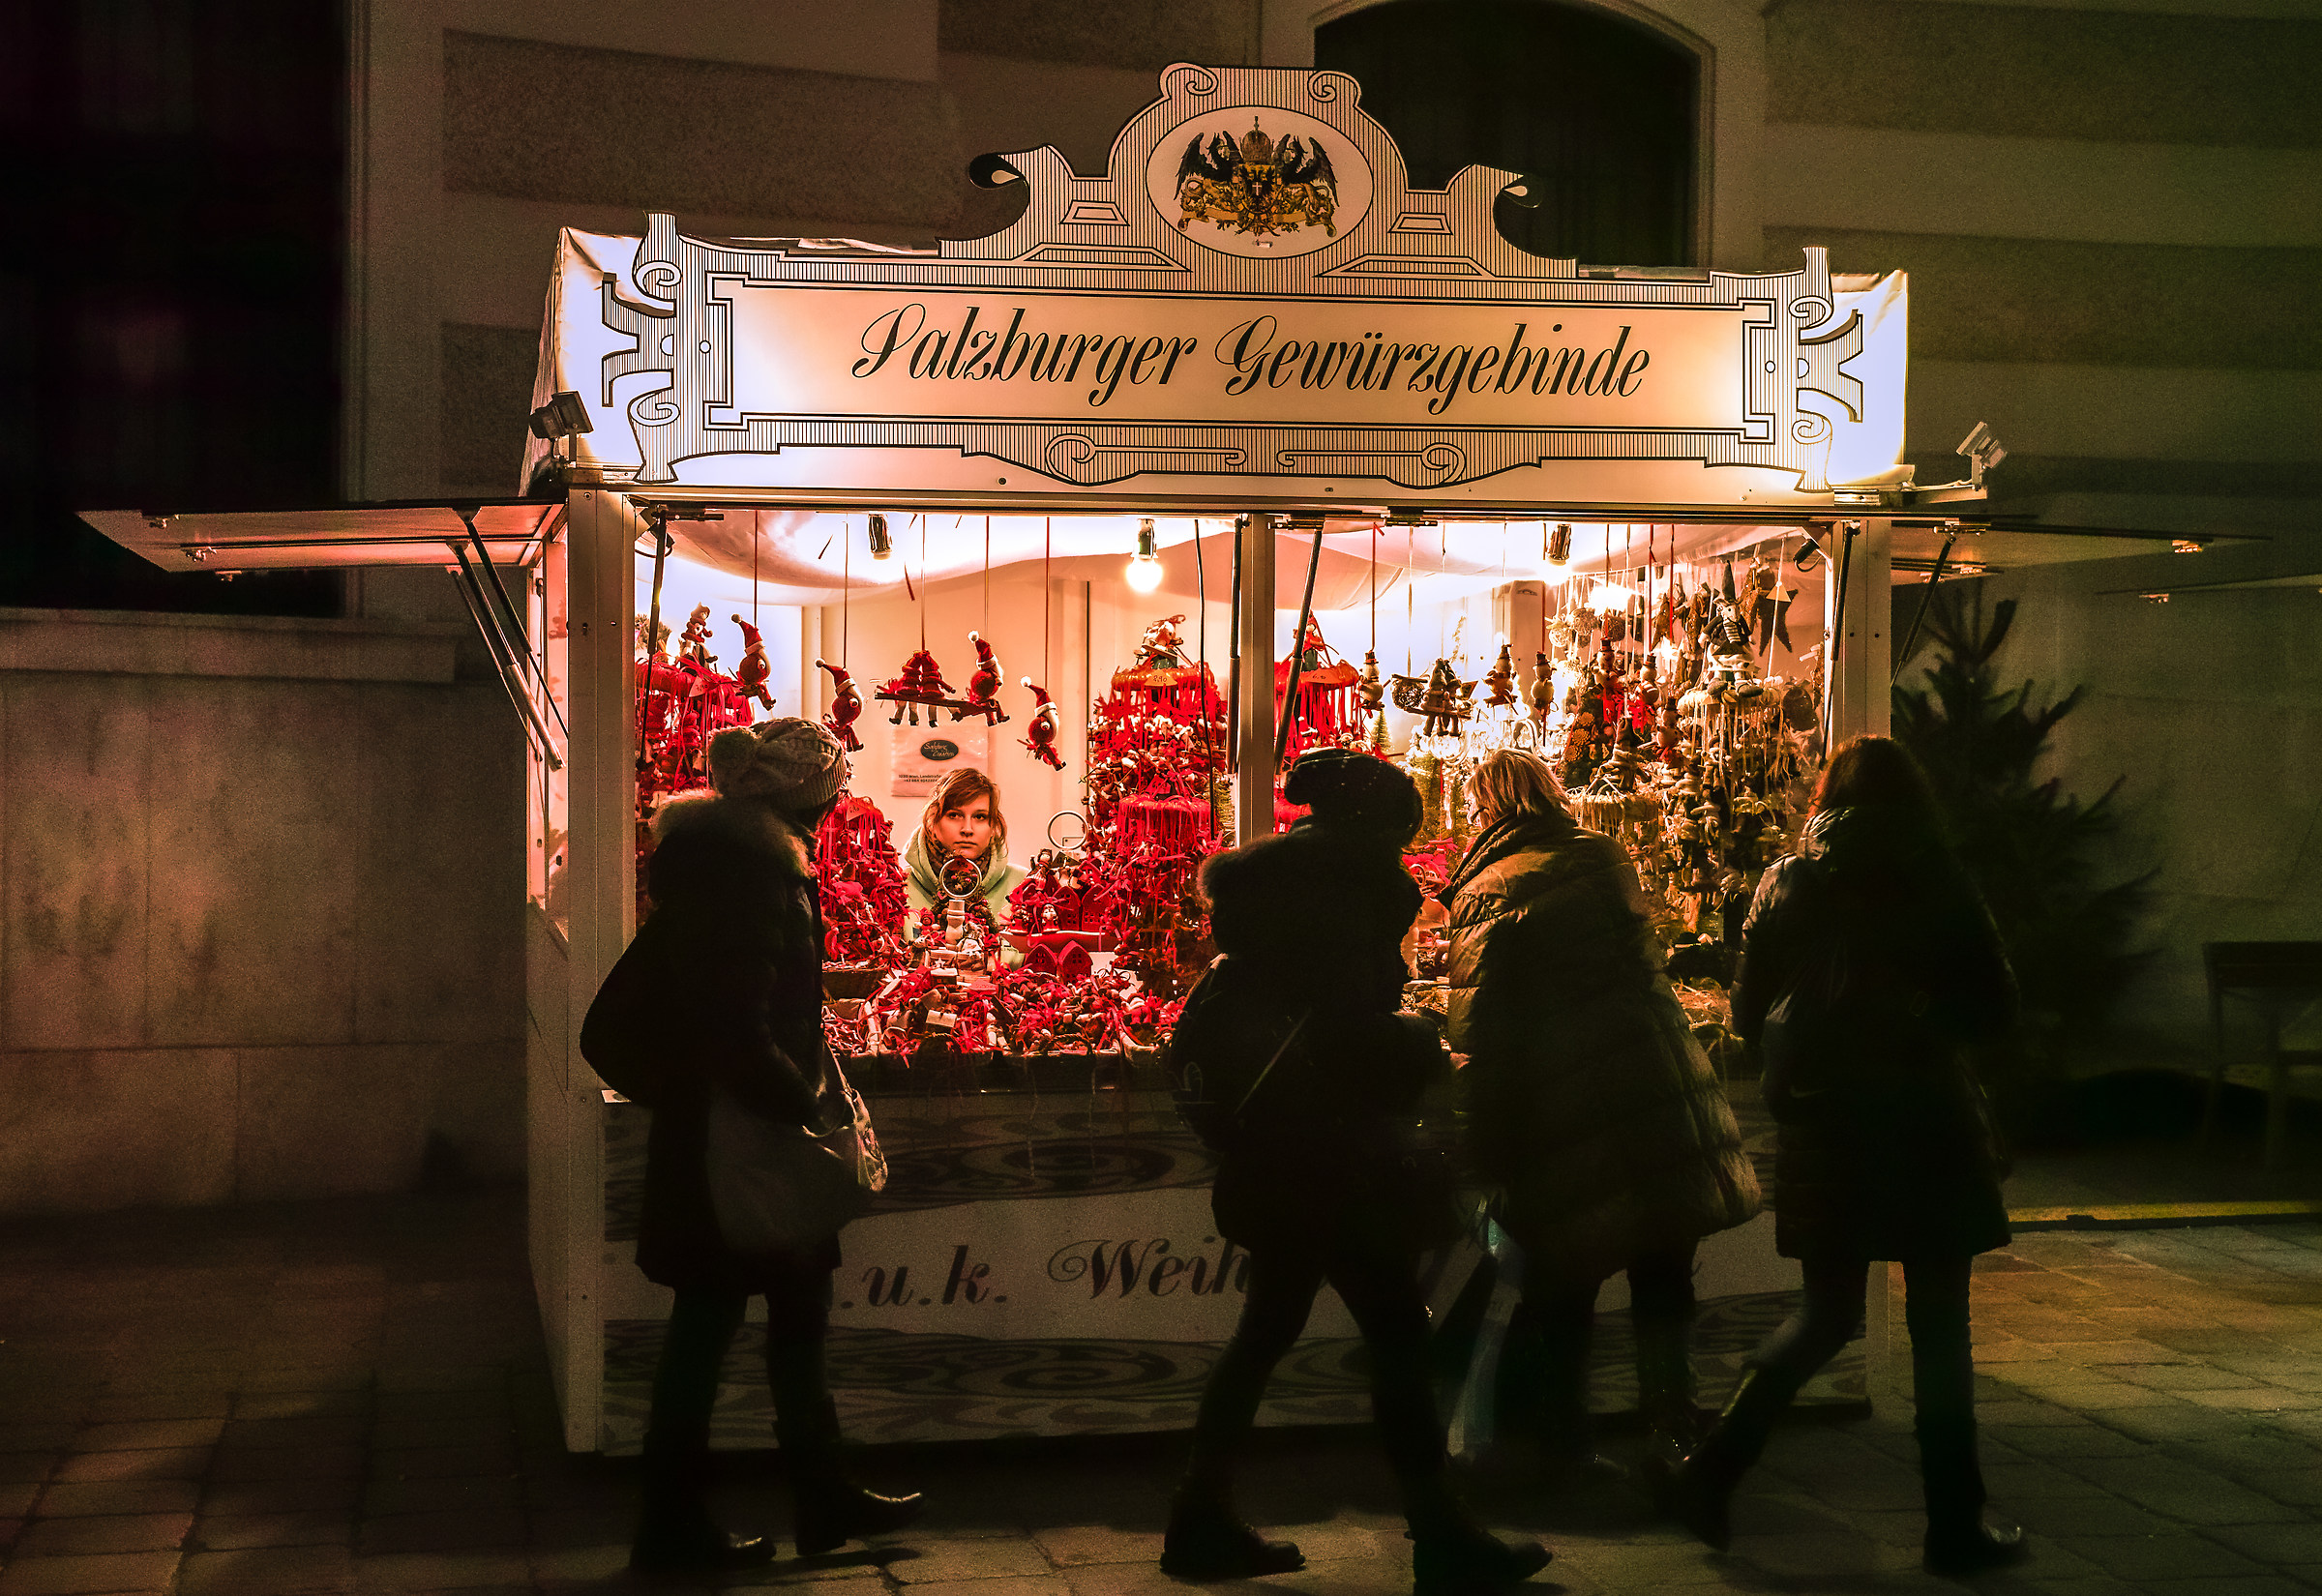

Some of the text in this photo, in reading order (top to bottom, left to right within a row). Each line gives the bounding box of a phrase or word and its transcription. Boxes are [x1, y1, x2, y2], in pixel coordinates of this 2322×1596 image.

[850, 303, 1651, 416] Salzburger Gewürzgebinde
[839, 1236, 1250, 1311] .u.k. Weih
